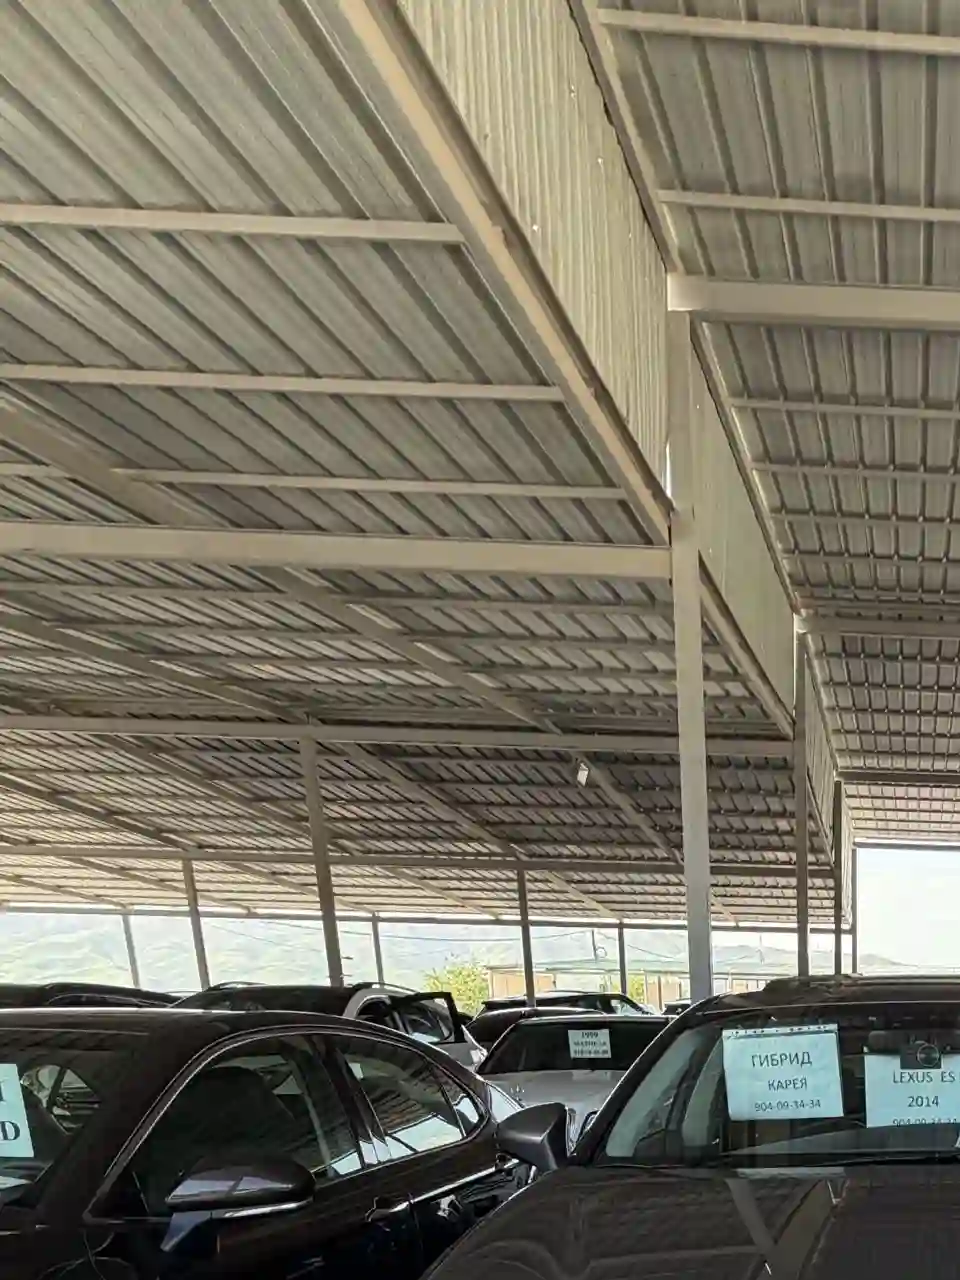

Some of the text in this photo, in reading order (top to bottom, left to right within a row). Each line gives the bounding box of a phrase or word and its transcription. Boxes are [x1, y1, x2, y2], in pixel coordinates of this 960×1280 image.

[751, 1051, 813, 1068] ГИБРИД
[768, 1077, 808, 1091] КАРЕЯ
[892, 1071, 933, 1084] LEXUS
[940, 1071, 956, 1083] ES
[907, 1095, 940, 1108] 2014
